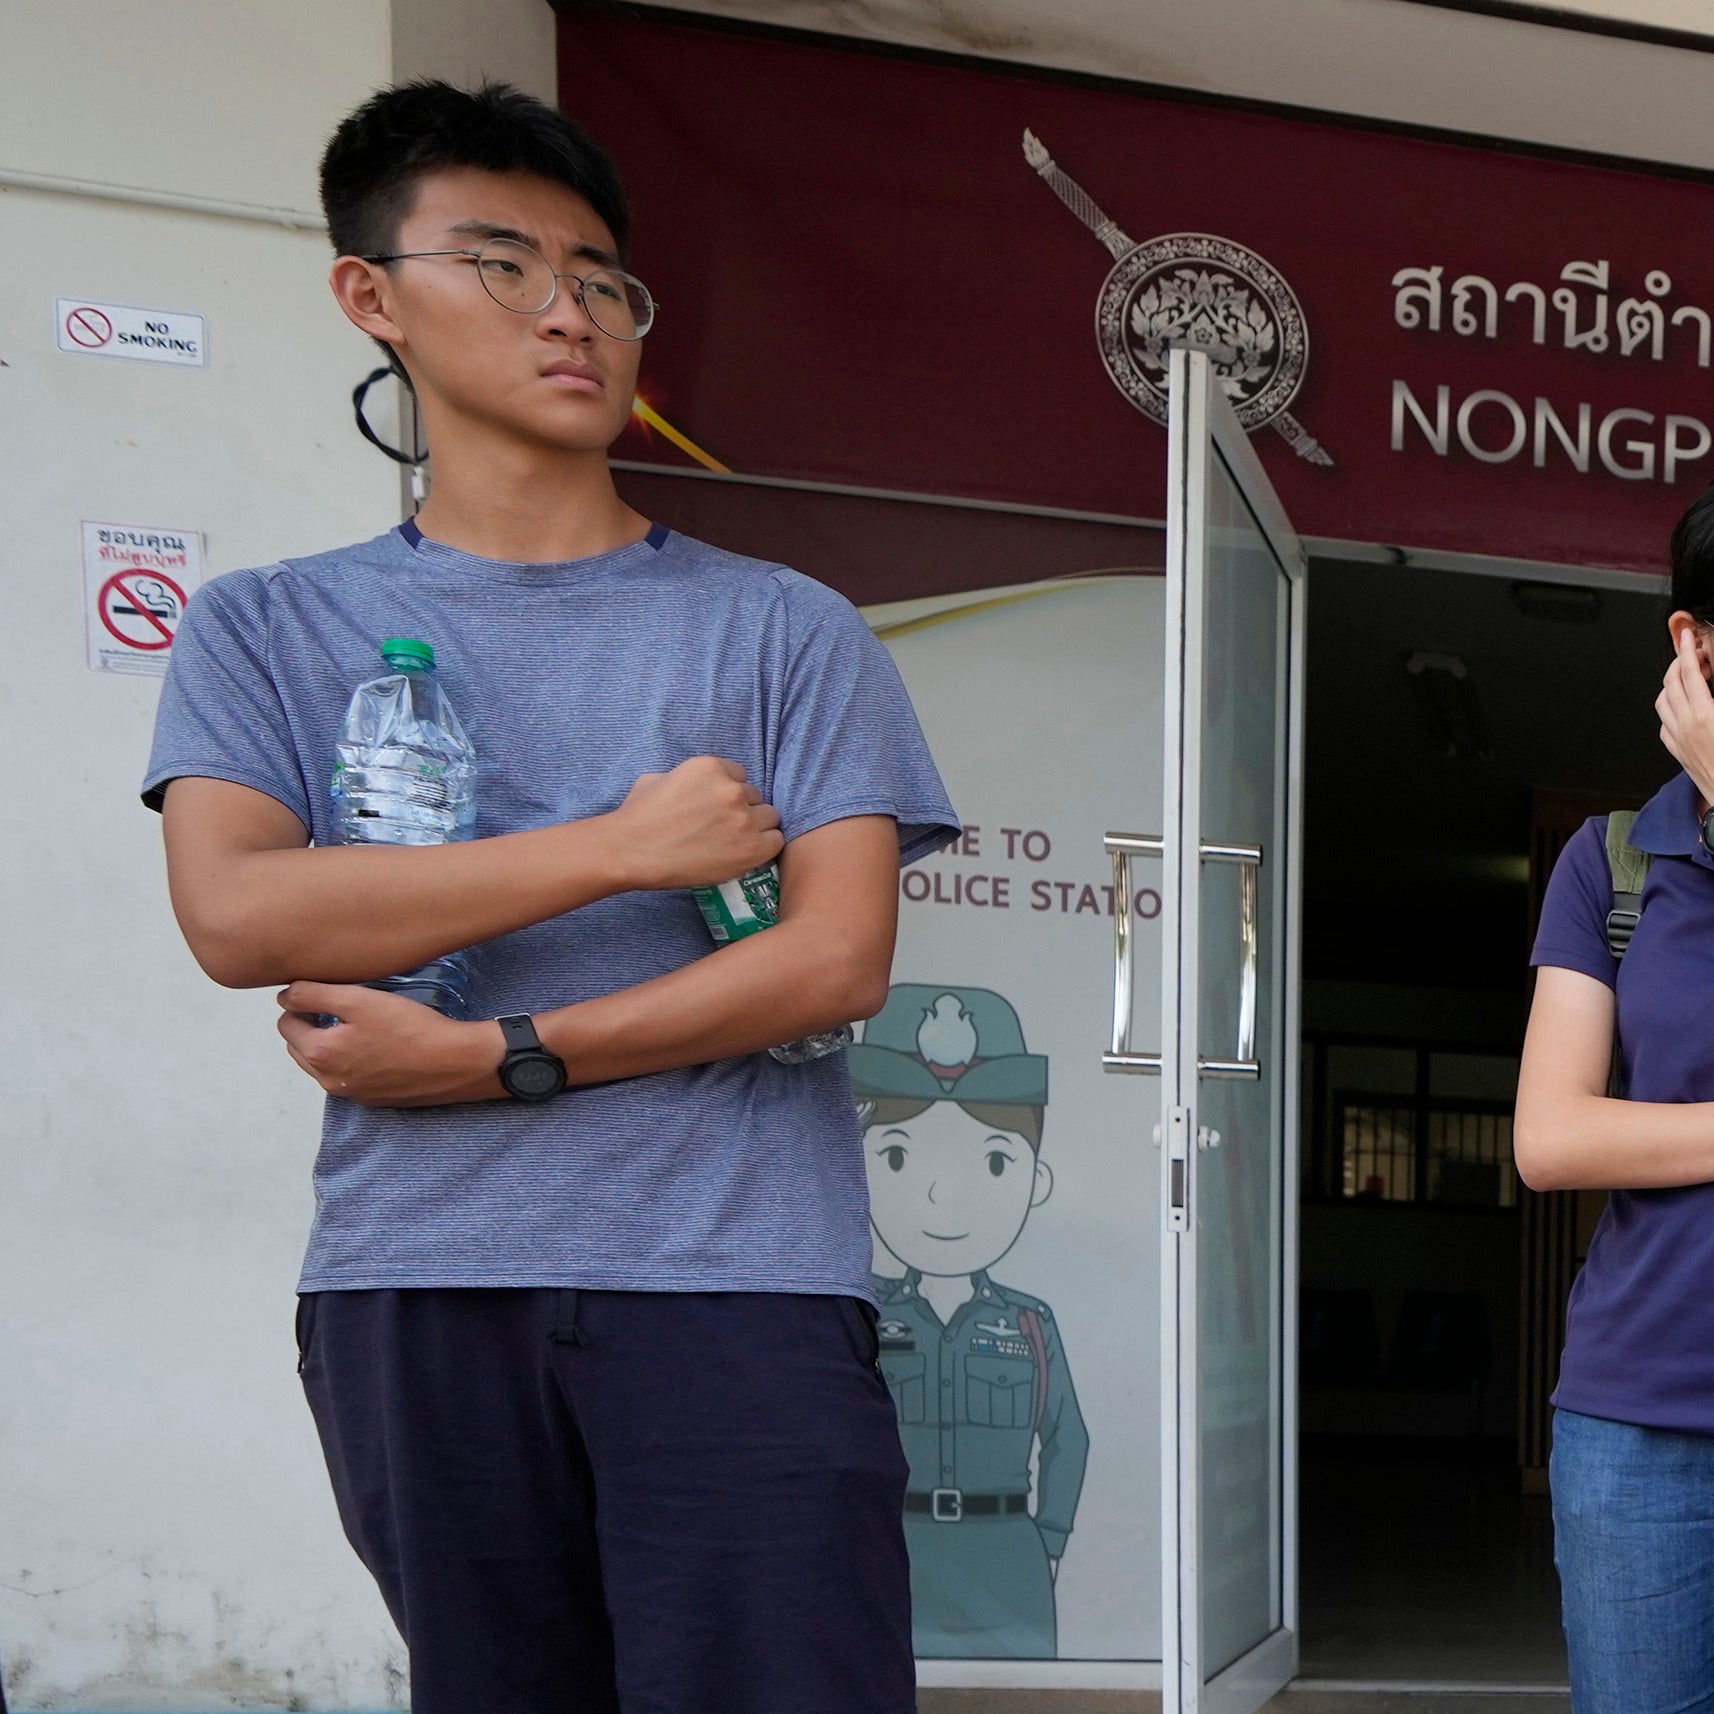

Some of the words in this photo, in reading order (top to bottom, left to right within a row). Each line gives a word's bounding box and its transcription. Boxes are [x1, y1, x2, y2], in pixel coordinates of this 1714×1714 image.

[117, 331, 198, 353] SMOKING
[144, 321, 169, 336] NO
[97, 527, 187, 554] ขอบคุณ
[1000, 827, 1052, 863] TO
[901, 869, 1010, 909] OLICE
[1030, 879, 1163, 920] STATO
